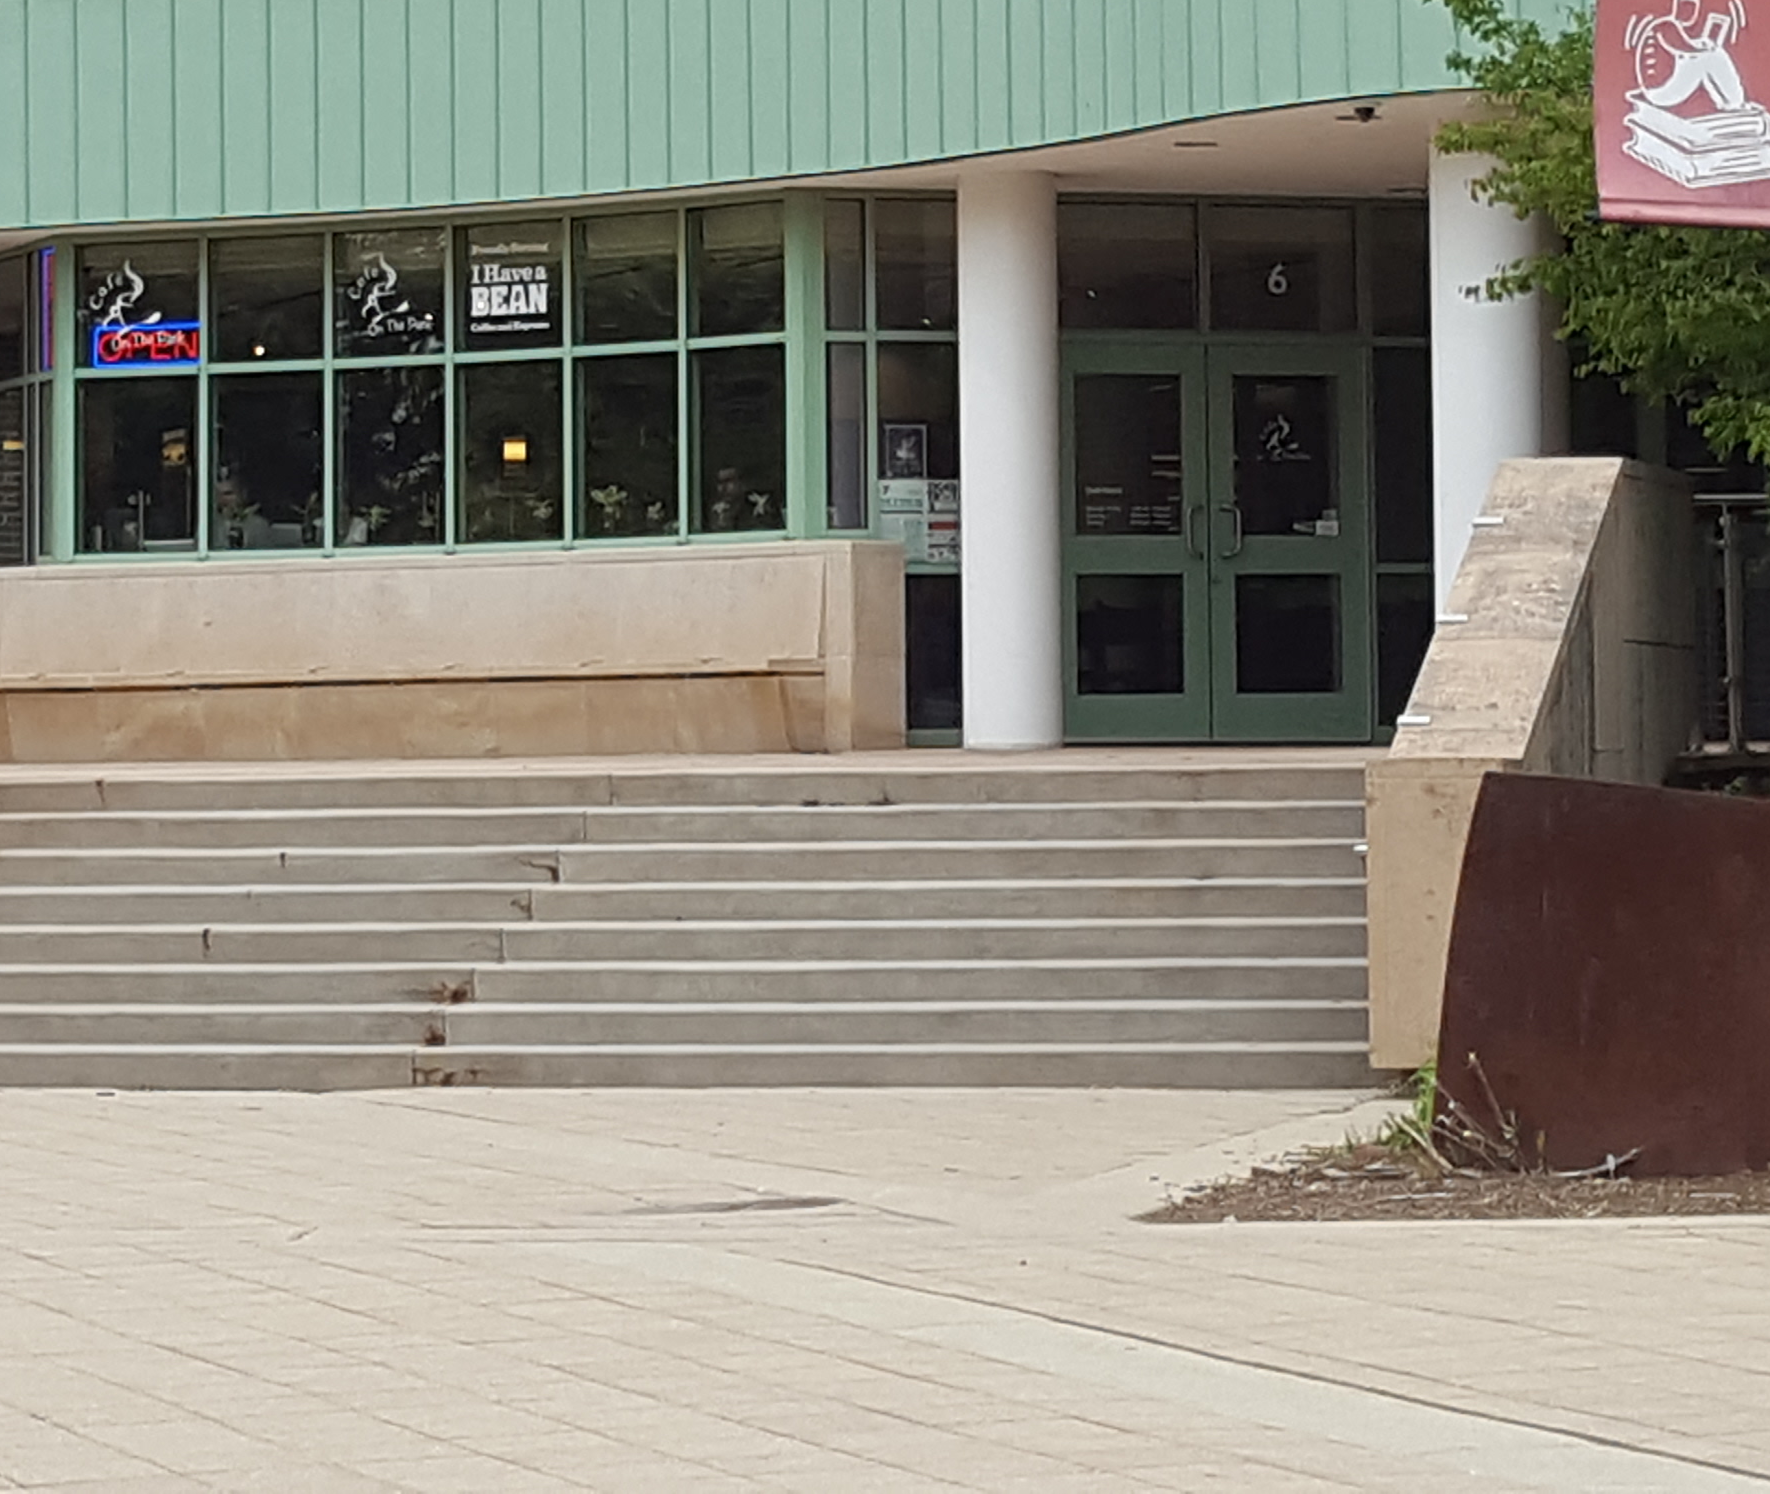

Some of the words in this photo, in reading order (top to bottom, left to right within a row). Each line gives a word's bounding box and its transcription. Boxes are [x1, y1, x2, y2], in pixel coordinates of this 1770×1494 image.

[470, 264, 481, 284] I
[483, 263, 533, 283] Have
[535, 266, 547, 281] a
[1268, 263, 1288, 294] 6
[470, 283, 549, 317] BEAN
[98, 330, 198, 363] OPEN
